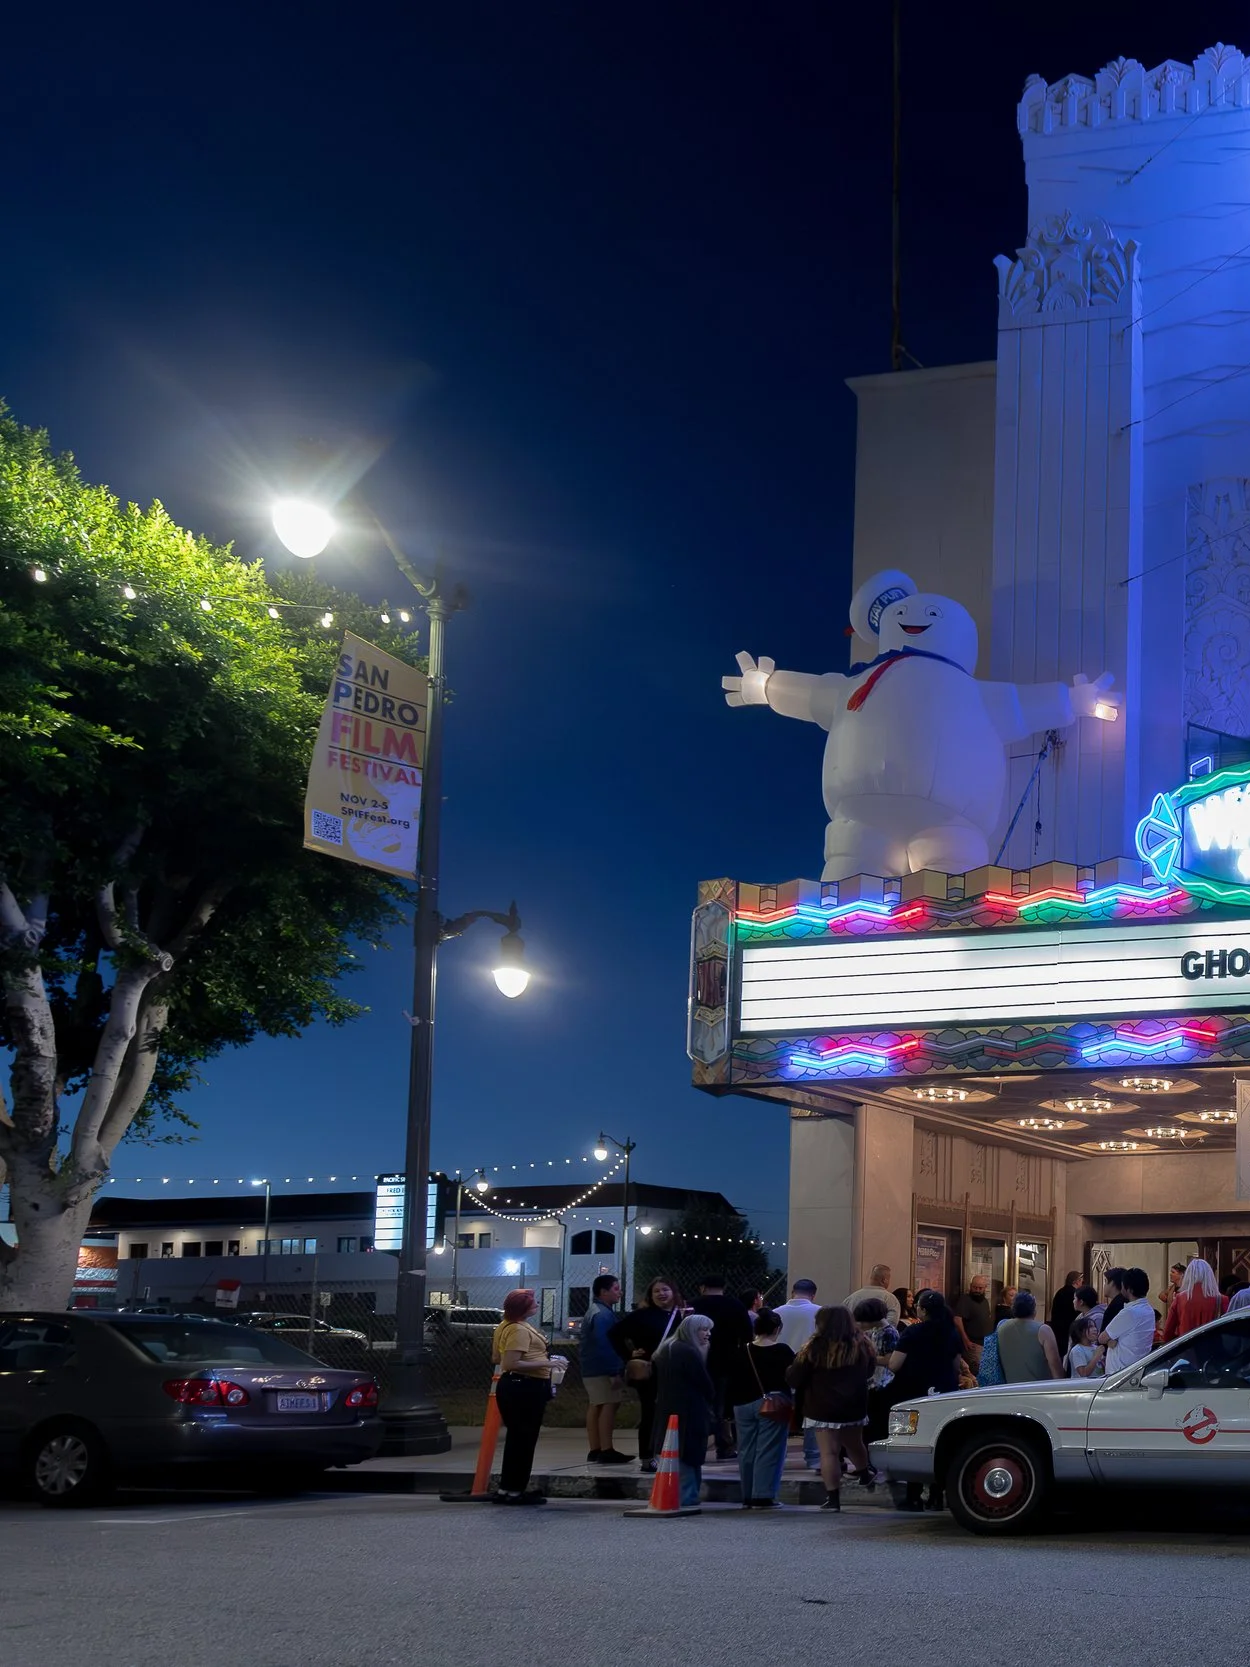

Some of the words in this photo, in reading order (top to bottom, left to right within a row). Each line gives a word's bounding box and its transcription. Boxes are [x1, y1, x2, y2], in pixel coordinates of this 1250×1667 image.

[869, 600, 883, 627] STAY
[337, 653, 389, 690] SAN
[333, 681, 419, 726] PEDRO
[331, 711, 420, 764] FILM
[327, 750, 422, 787] FESTIVAL
[340, 792, 367, 806] NOV
[371, 799, 389, 810] 2-5
[341, 806, 410, 829] SPIFFest.org
